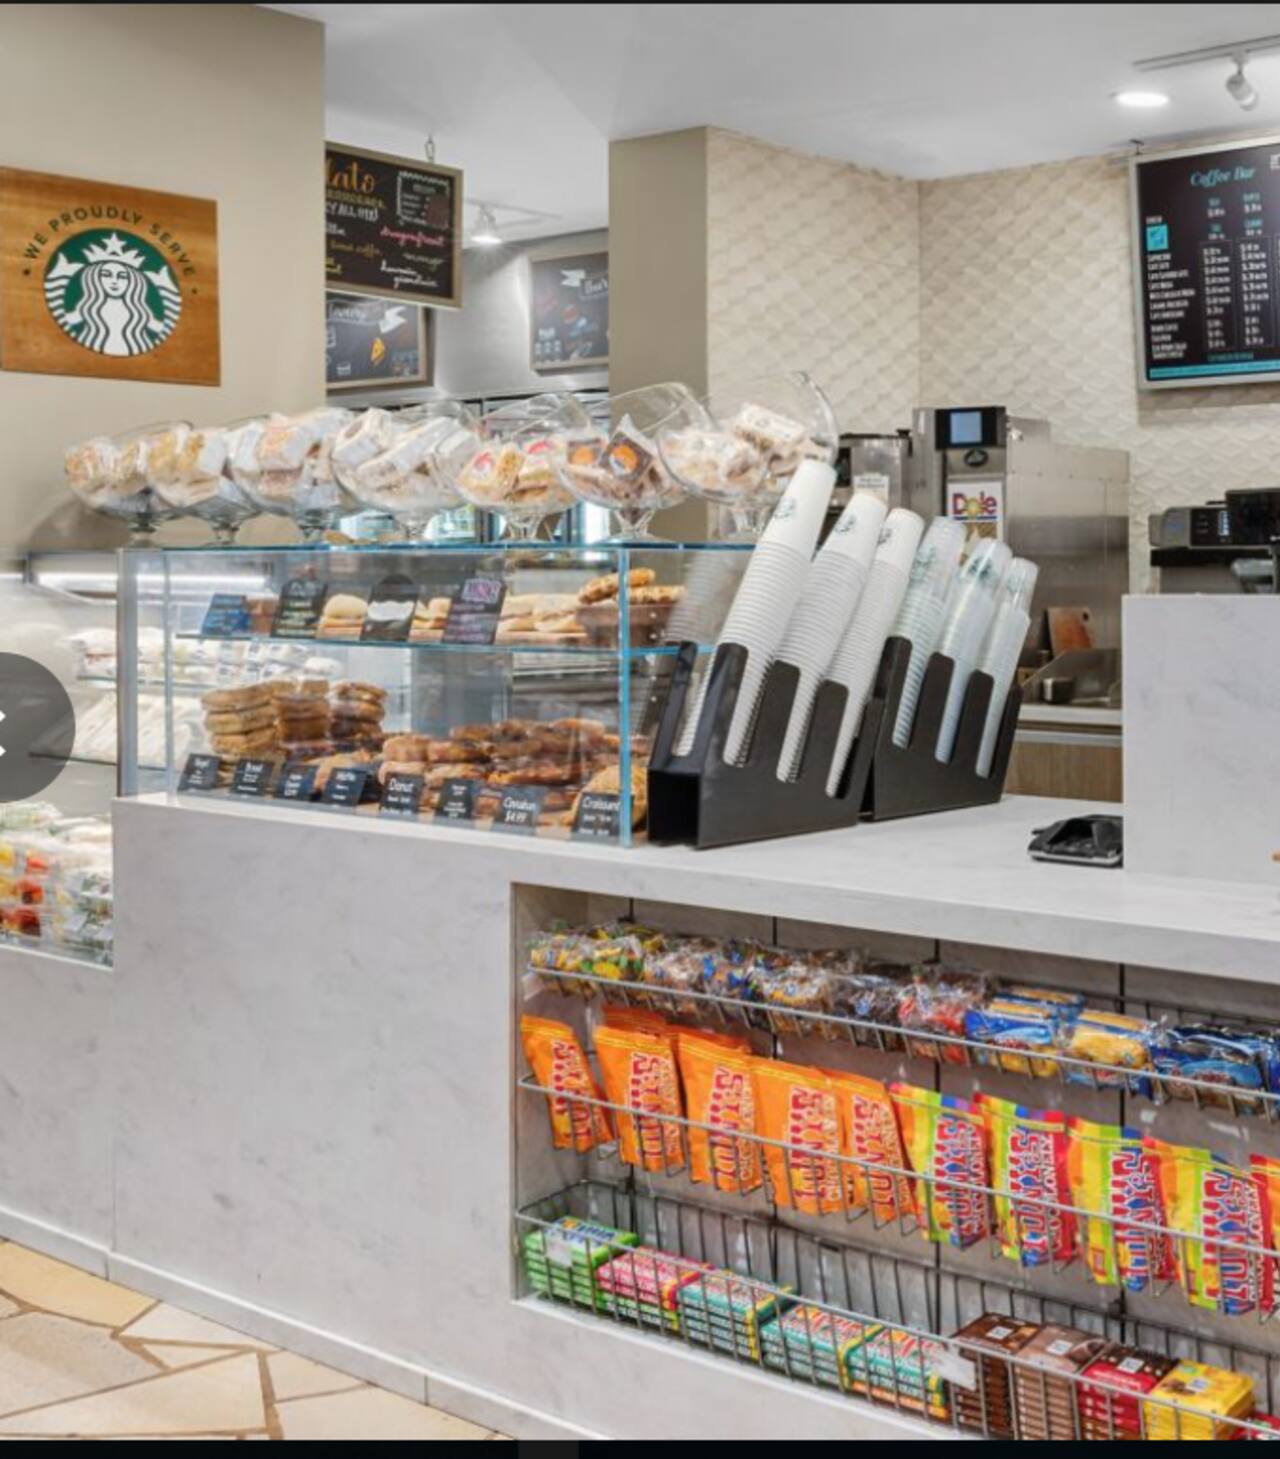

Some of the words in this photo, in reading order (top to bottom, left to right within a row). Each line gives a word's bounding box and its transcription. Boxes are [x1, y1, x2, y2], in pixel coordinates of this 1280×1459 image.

[1190, 168, 1231, 188] Coffee
[1233, 166, 1256, 181] Bar
[23, 232, 48, 260] WE
[48, 205, 143, 233] PROUDLY
[149, 222, 196, 277] SERVE
[952, 491, 998, 516] Dole
